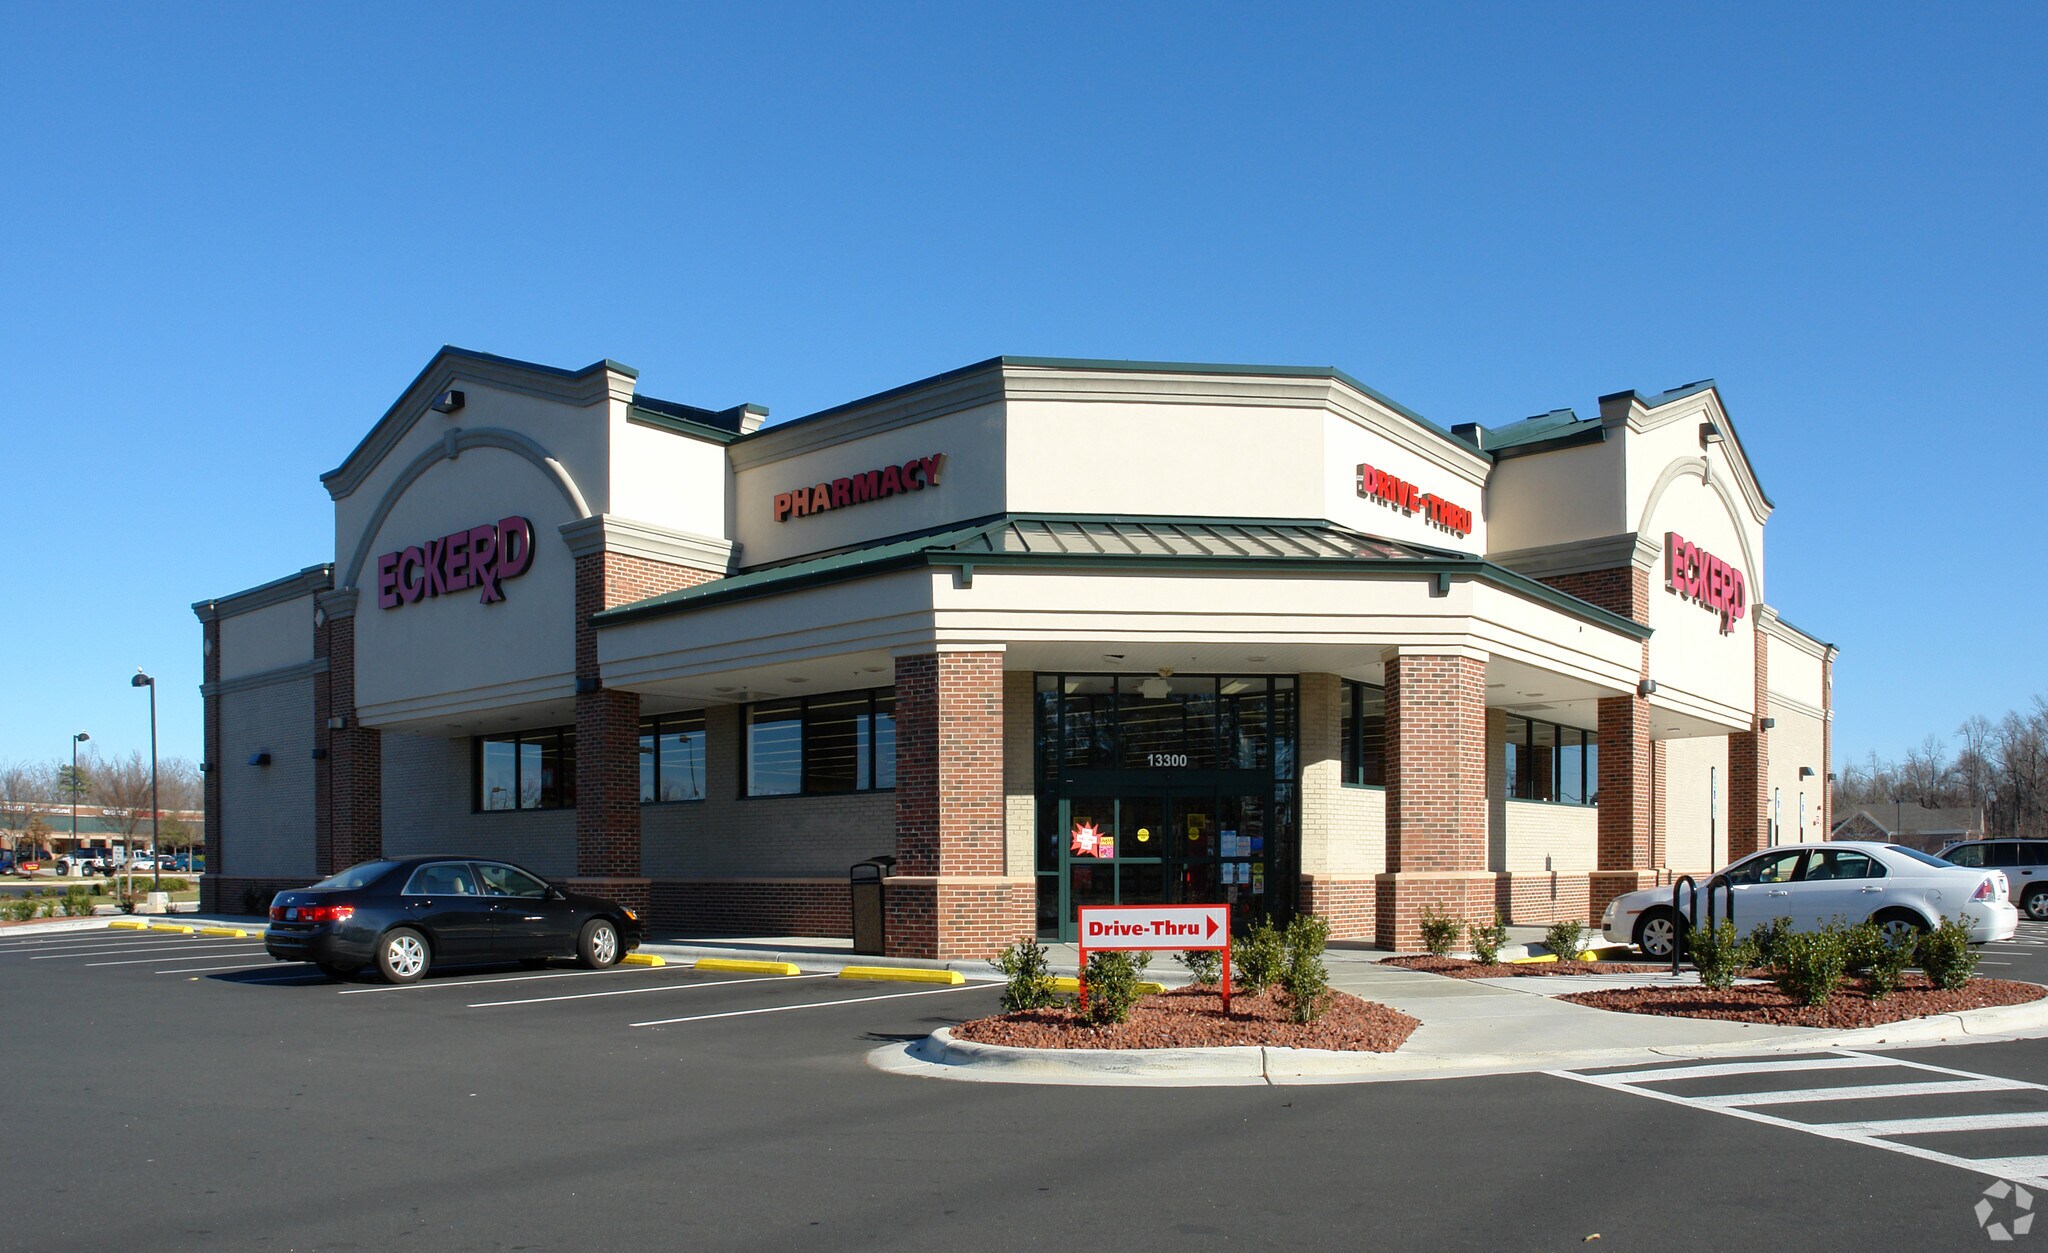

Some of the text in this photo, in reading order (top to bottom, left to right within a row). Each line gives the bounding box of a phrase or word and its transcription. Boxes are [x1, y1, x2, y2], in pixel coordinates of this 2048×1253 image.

[774, 453, 944, 522] PHARMACY
[1360, 463, 1472, 536] DRIVE-THRU
[378, 515, 534, 609] ECKERD
[1667, 532, 1746, 634] ECKERD
[1147, 754, 1188, 767] 13300
[1089, 920, 1200, 936] Drive-Thru
